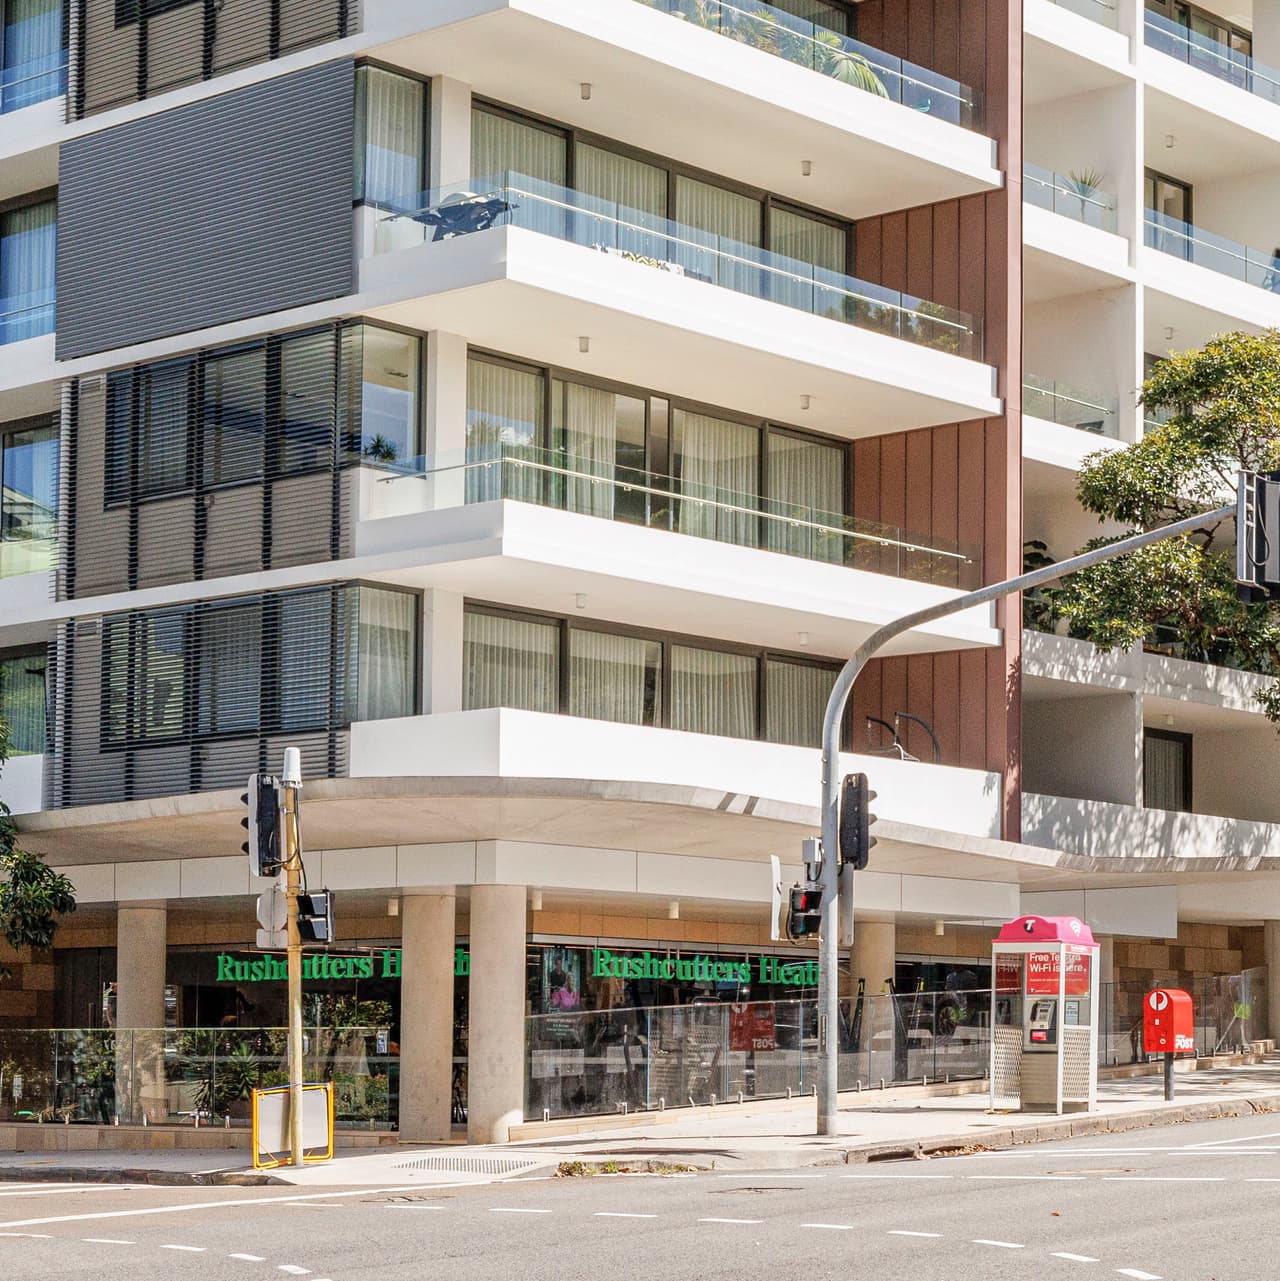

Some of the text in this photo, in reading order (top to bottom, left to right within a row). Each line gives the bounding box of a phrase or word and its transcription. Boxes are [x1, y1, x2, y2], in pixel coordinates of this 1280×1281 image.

[1029, 952, 1048, 962] Free
[592, 949, 752, 984] Rushcutters
[1029, 963, 1052, 972] Wi-Fi
[1175, 1038, 1194, 1049] POST
